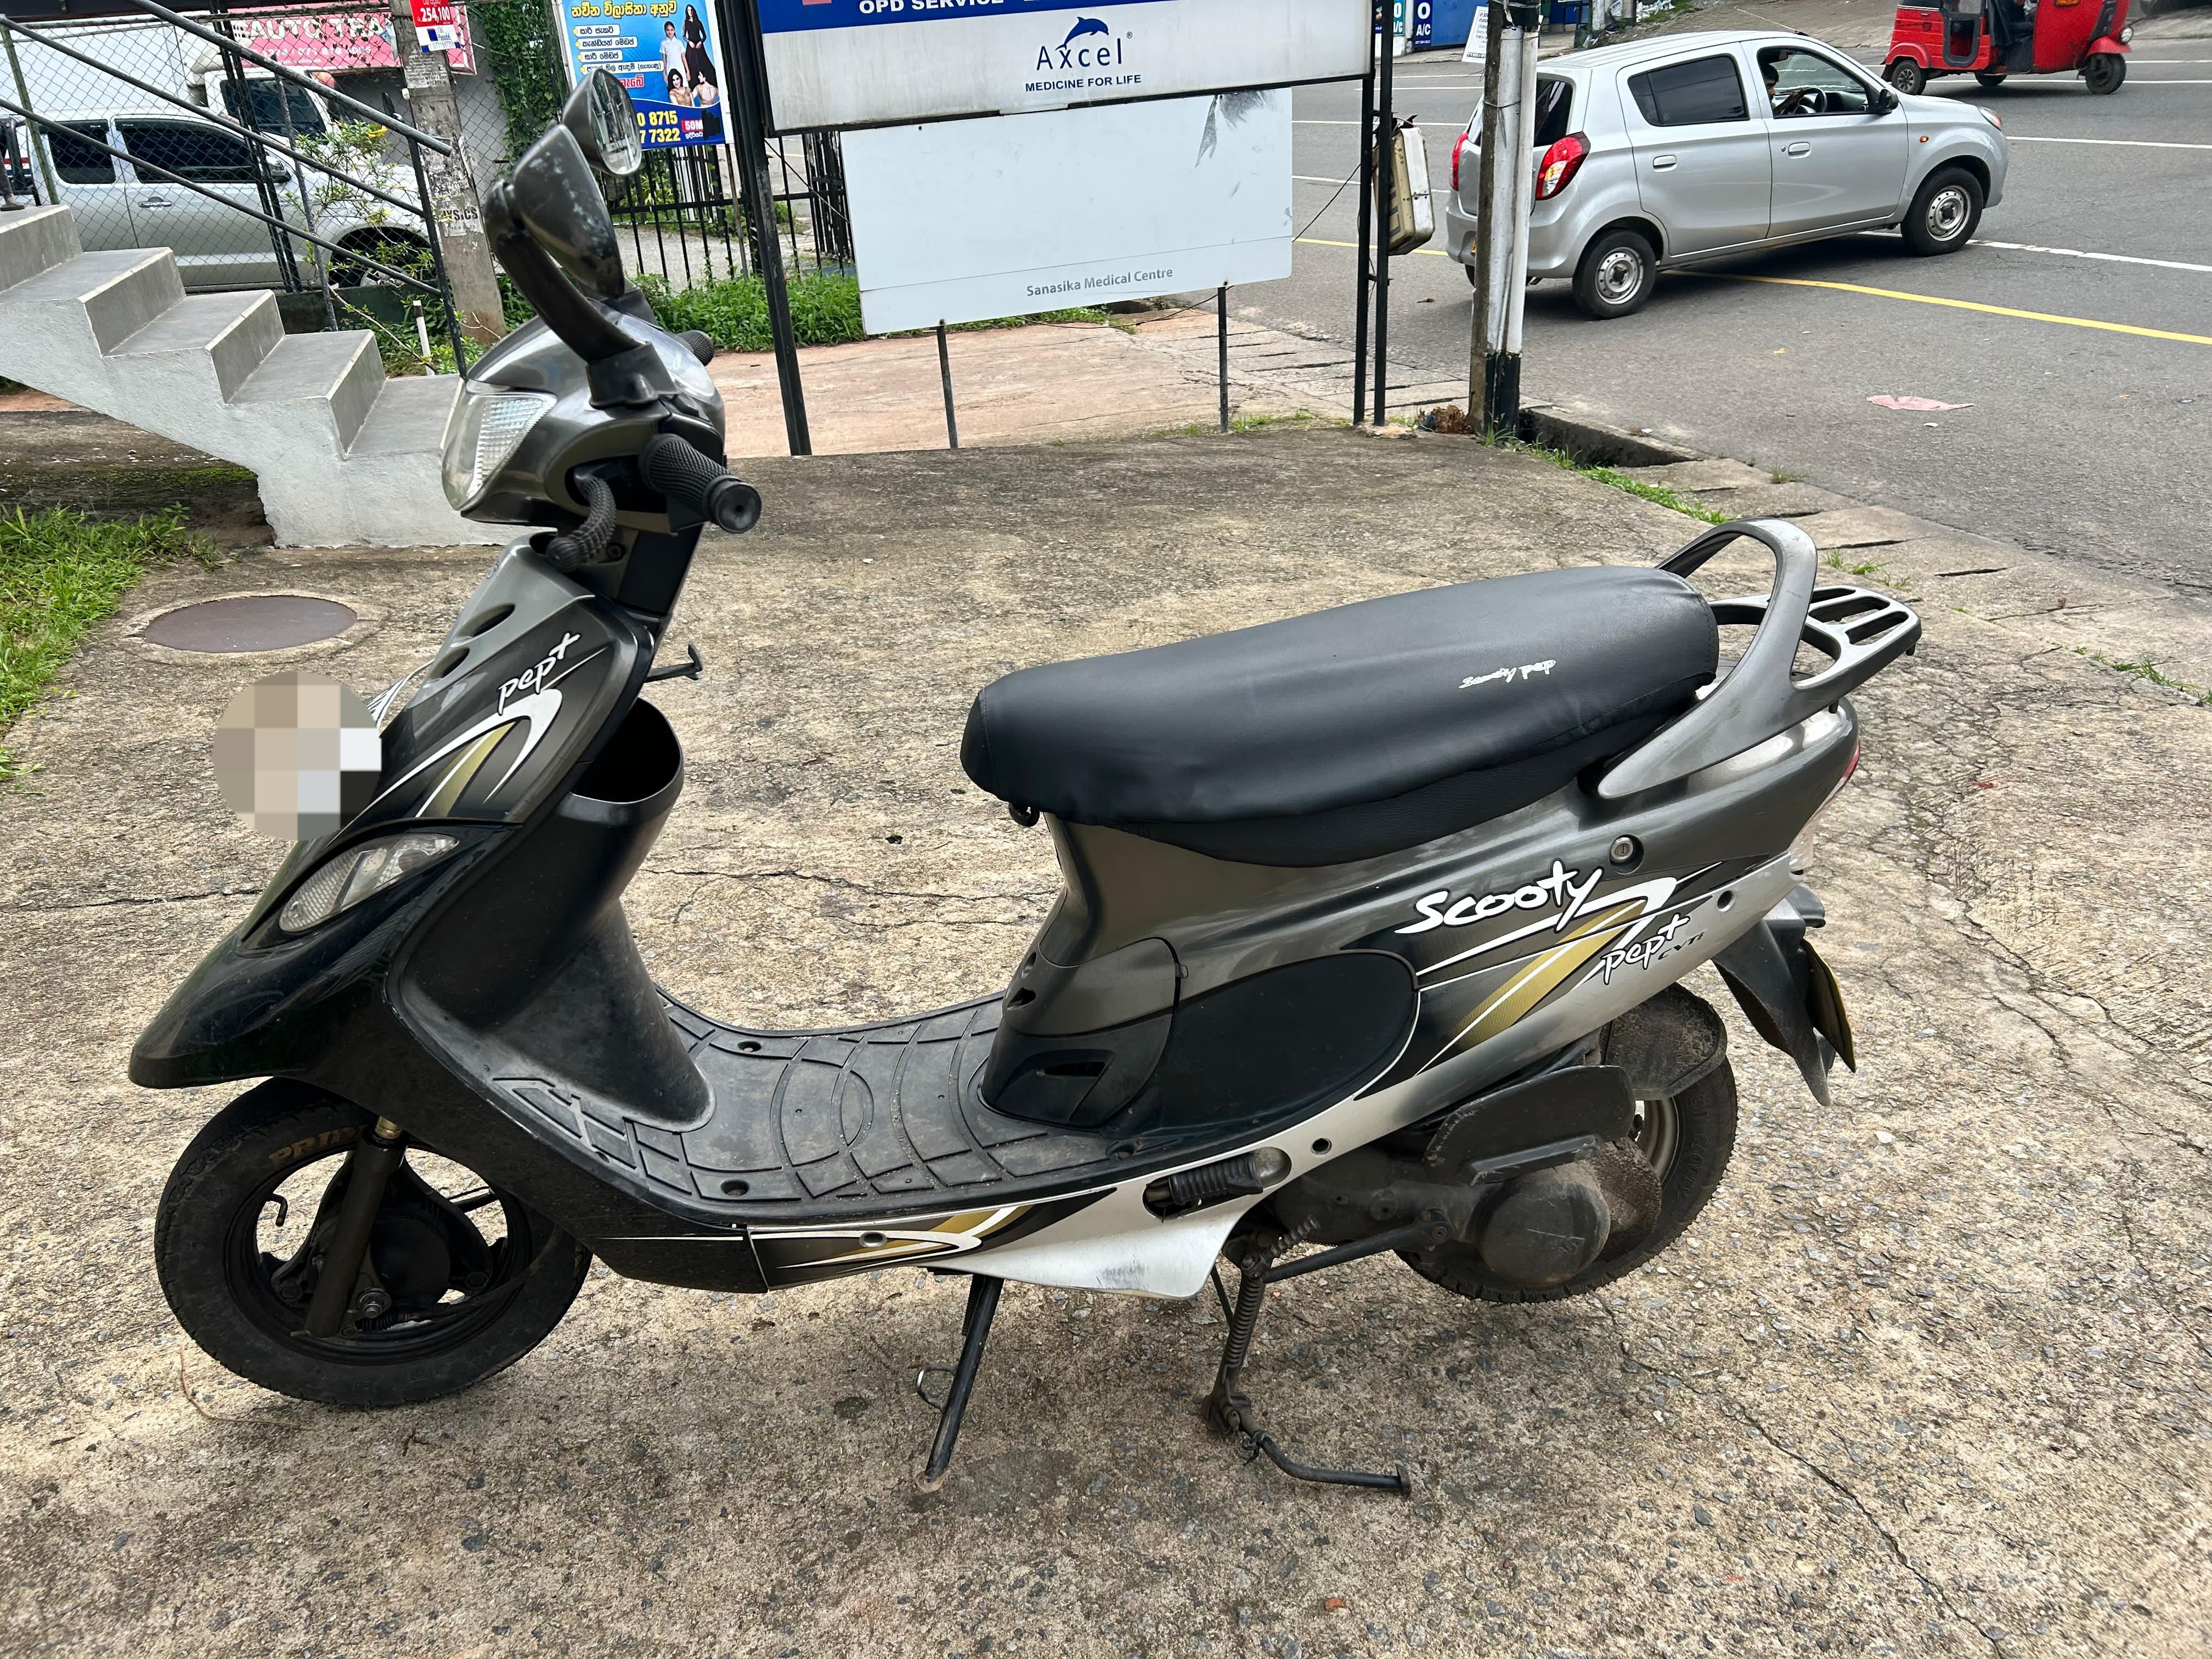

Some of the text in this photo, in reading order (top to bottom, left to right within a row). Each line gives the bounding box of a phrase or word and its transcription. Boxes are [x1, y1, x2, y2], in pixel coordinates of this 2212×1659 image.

[420, 6, 450, 23] 254,100
[604, 1, 646, 19] විලාසිතා
[650, 1, 677, 17] අනුව
[859, 0, 905, 14] OPD
[250, 18, 322, 40] AUTO
[1416, 24, 1431, 36] A/C
[1036, 38, 1122, 71] Axcel
[1025, 75, 1142, 92] MEDICINE FOR LIFE
[648, 110, 678, 126] 8715
[649, 127, 681, 143] 7322
[1026, 268, 1173, 296] Sanasika Medical Centre
[1395, 860, 1603, 934] Scooty
